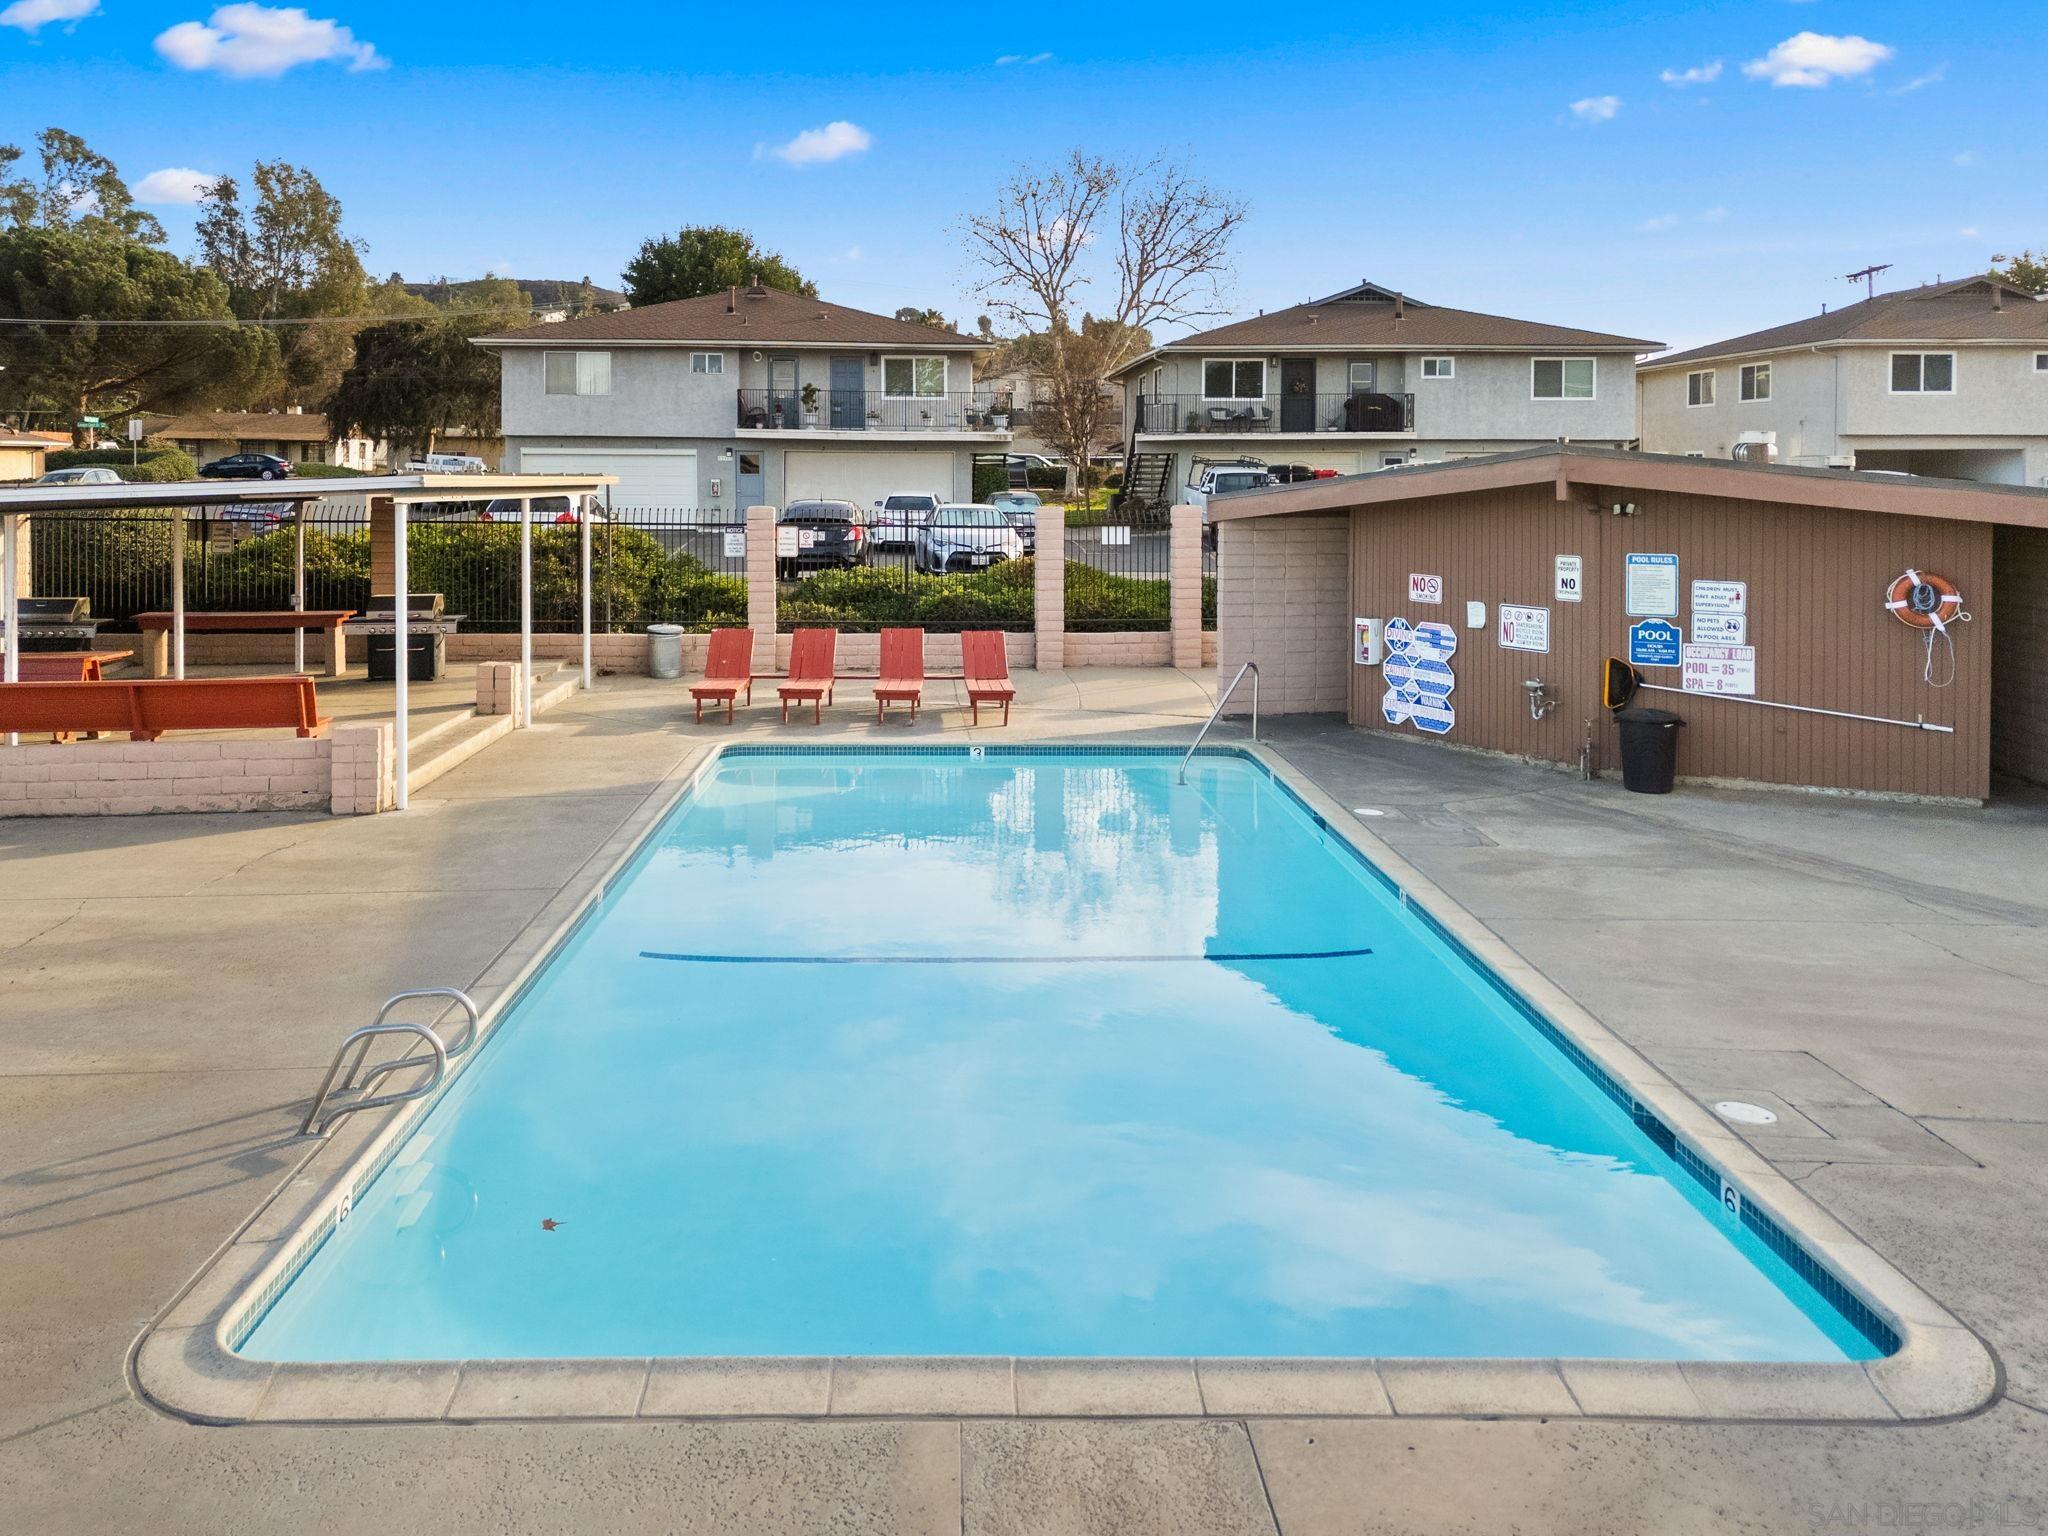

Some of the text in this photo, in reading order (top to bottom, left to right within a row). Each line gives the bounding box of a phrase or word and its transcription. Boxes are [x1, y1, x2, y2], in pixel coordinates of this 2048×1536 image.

[1412, 576, 1426, 592] NO
[1561, 578, 1576, 590] NO
[1395, 619, 1406, 630] NO
[1387, 629, 1413, 641] DIVING
[1503, 621, 1515, 643] NO
[1638, 630, 1673, 641] POOL
[1686, 646, 1752, 660] OCCUPANCY LOAD
[1385, 664, 1411, 678] CAUTION
[1685, 663, 1709, 674] POOL
[1722, 664, 1734, 675] 35
[1685, 678, 1704, 690] SPA
[1717, 680, 1723, 690] 8
[1421, 694, 1445, 710] WARNING
[1725, 1187, 1736, 1213] 6
[340, 1195, 349, 1222] 6
